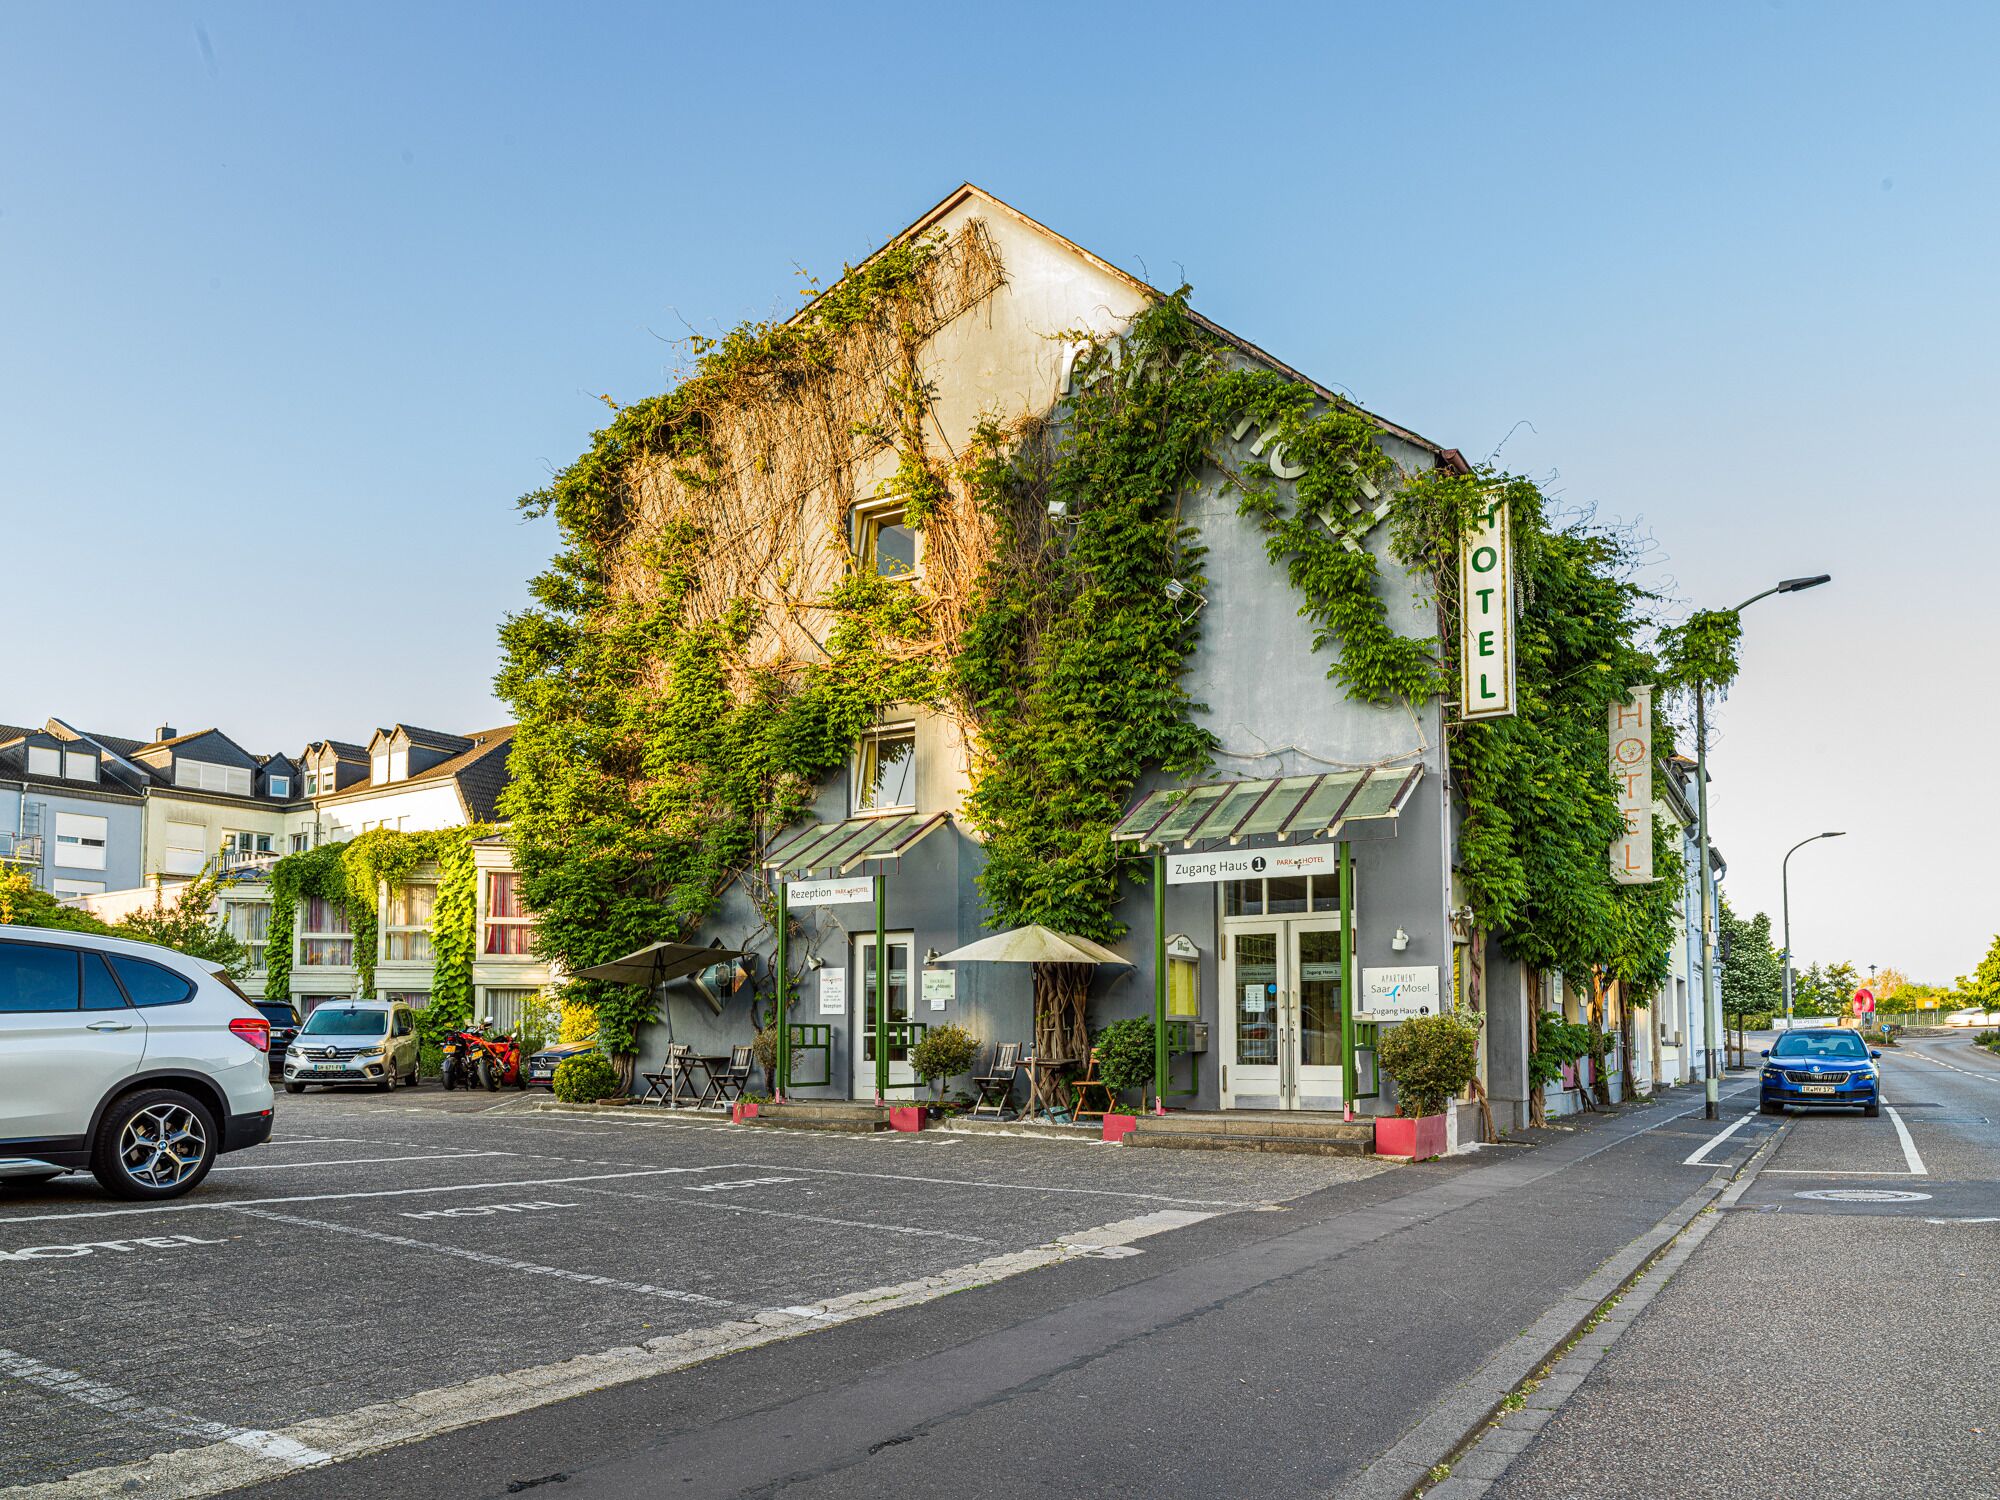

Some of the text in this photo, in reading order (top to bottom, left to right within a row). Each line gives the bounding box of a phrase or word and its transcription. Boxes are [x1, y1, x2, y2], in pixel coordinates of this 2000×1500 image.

[1615, 702, 1646, 870] HOTEL
[1175, 856, 1325, 876] Zugang Haus 1 PARK HOTEL
[791, 888, 832, 900] Rezeption
[1381, 974, 1416, 982] APARTMENT
[1371, 984, 1430, 993] Saar Mosel
[1372, 1007, 1399, 1016] Zugang
[397, 1201, 580, 1219] HOTEL
